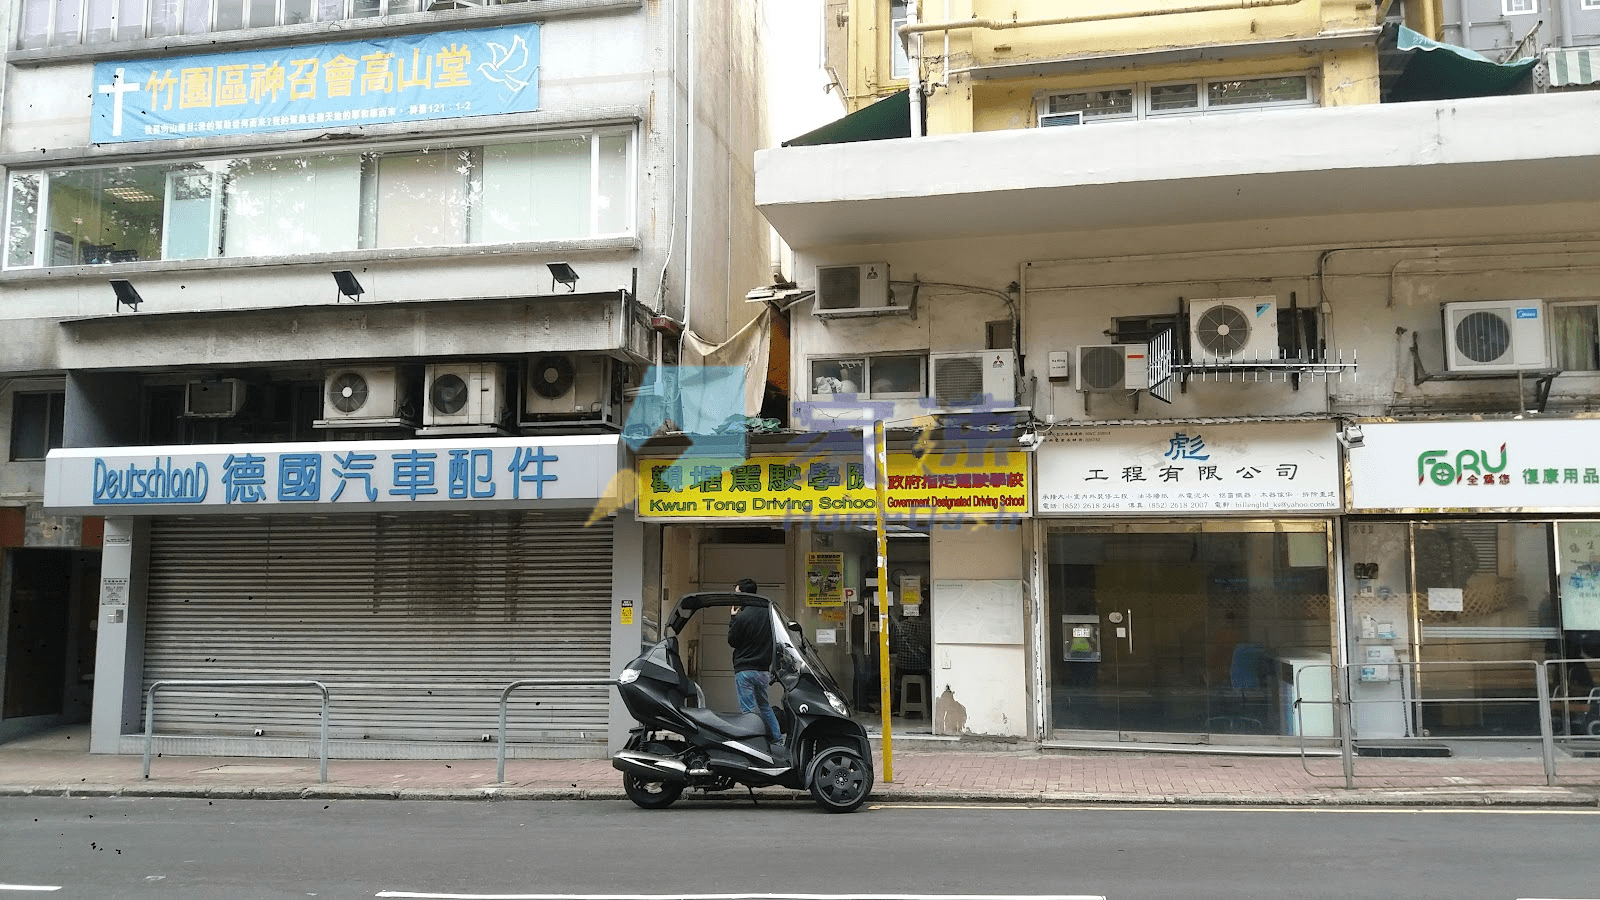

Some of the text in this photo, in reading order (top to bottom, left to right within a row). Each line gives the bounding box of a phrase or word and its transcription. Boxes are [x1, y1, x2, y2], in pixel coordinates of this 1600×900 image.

[146, 43, 472, 111] 竹園區神召會高山堂
[1164, 433, 1210, 461] 彪
[221, 447, 558, 504] 德國汽車配件
[1084, 464, 1298, 483] 工程有限公司
[1522, 467, 1599, 485] 復康用品
[649, 498, 698, 512] Kwun
[702, 498, 747, 514] Tong
[752, 497, 813, 512] Driving
[887, 495, 1025, 510] Government Designated Driving School
